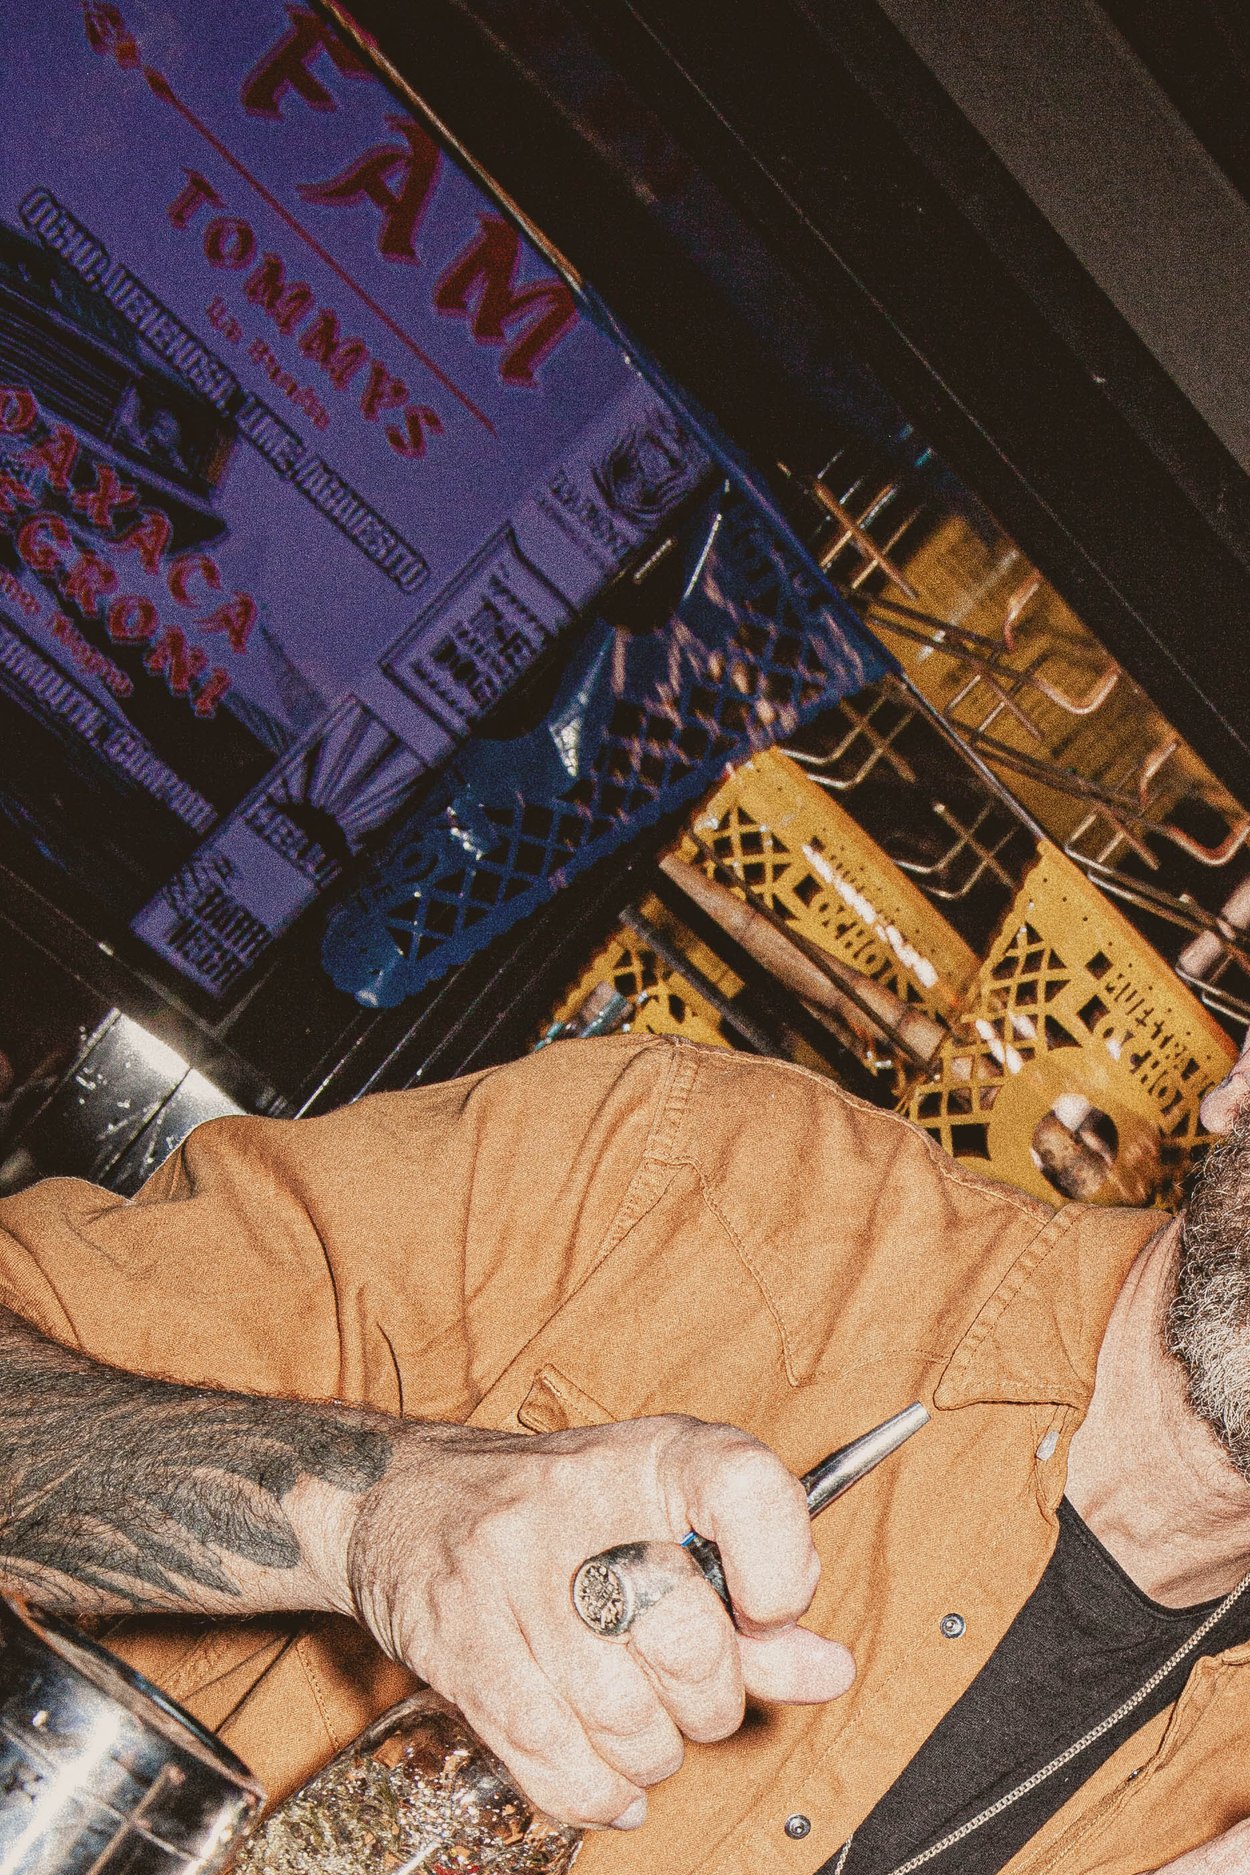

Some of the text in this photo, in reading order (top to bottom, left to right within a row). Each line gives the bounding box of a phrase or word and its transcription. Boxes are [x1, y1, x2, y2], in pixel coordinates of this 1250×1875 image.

[167, 166, 446, 459] TOMMYS
[241, 4, 581, 388] FAM
[0, 386, 257, 653] OAXACA
[805, 887, 889, 977] OCHO
[1092, 1011, 1181, 1108] OCHO
